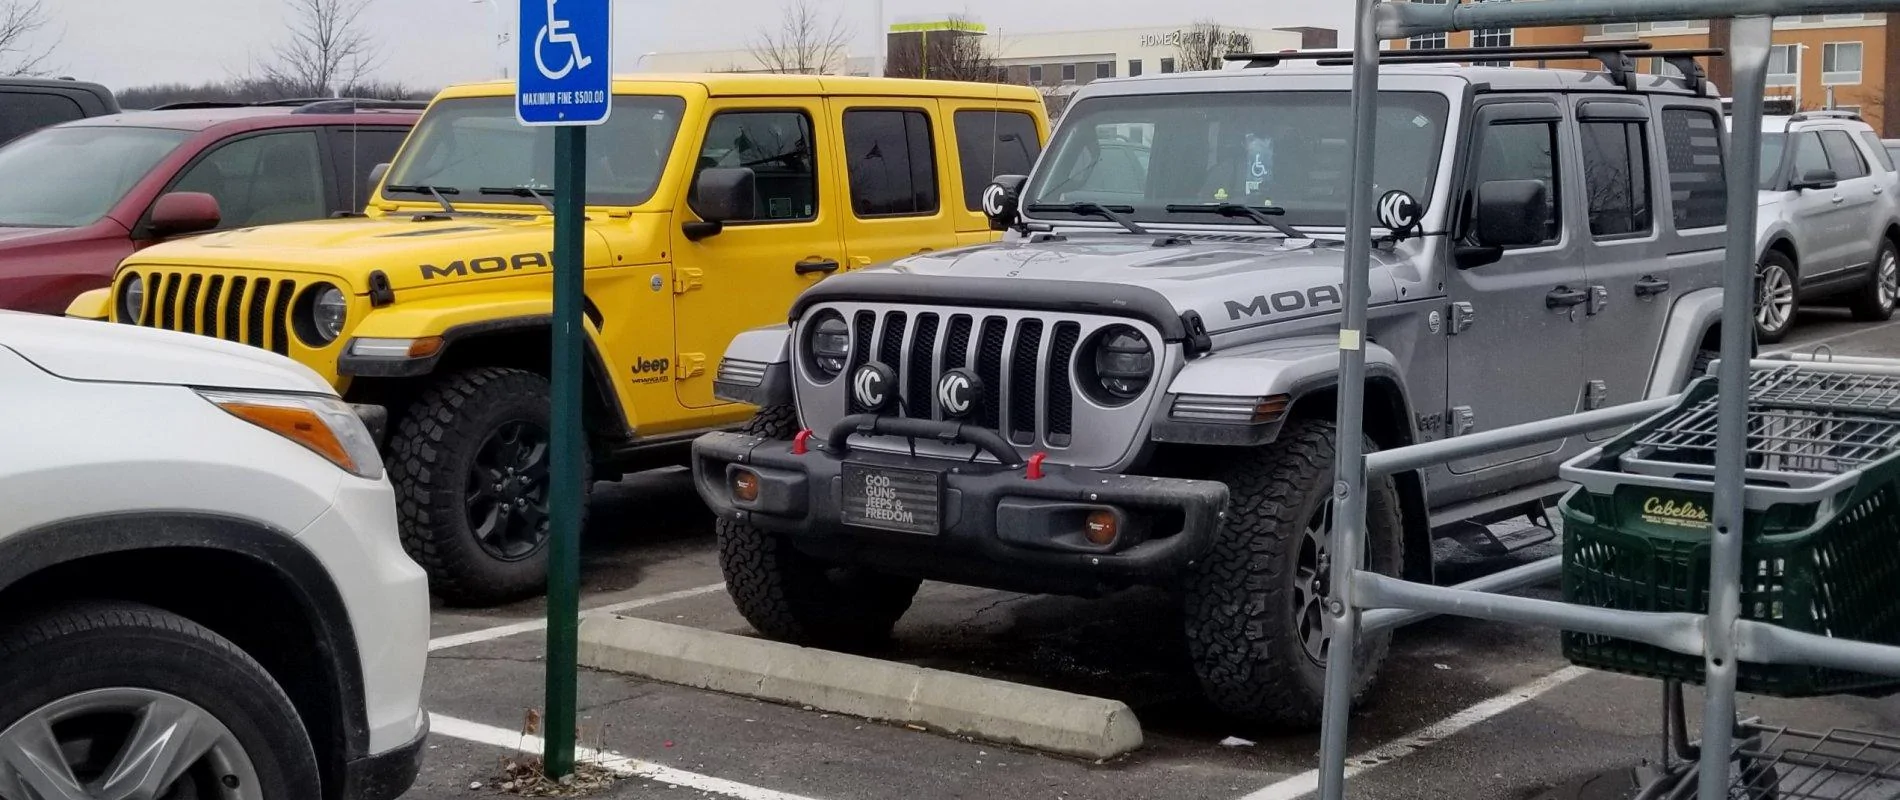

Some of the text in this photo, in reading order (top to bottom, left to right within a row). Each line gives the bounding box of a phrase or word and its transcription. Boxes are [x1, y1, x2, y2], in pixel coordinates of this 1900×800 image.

[522, 90, 604, 106] MAXIMUM FINE $500.00
[983, 184, 1004, 216] KC
[1380, 193, 1412, 229] KC
[419, 251, 555, 280] MOA
[1224, 284, 1371, 320] MOA
[631, 356, 669, 374] Jeep
[854, 369, 883, 407] KC
[939, 375, 970, 413] KC
[865, 474, 890, 487] GOD
[865, 486, 896, 499] GUNS
[865, 497, 904, 511] JEEPS &
[865, 508, 914, 523] FREEDOM
[1644, 497, 1708, 520] Cabela's
